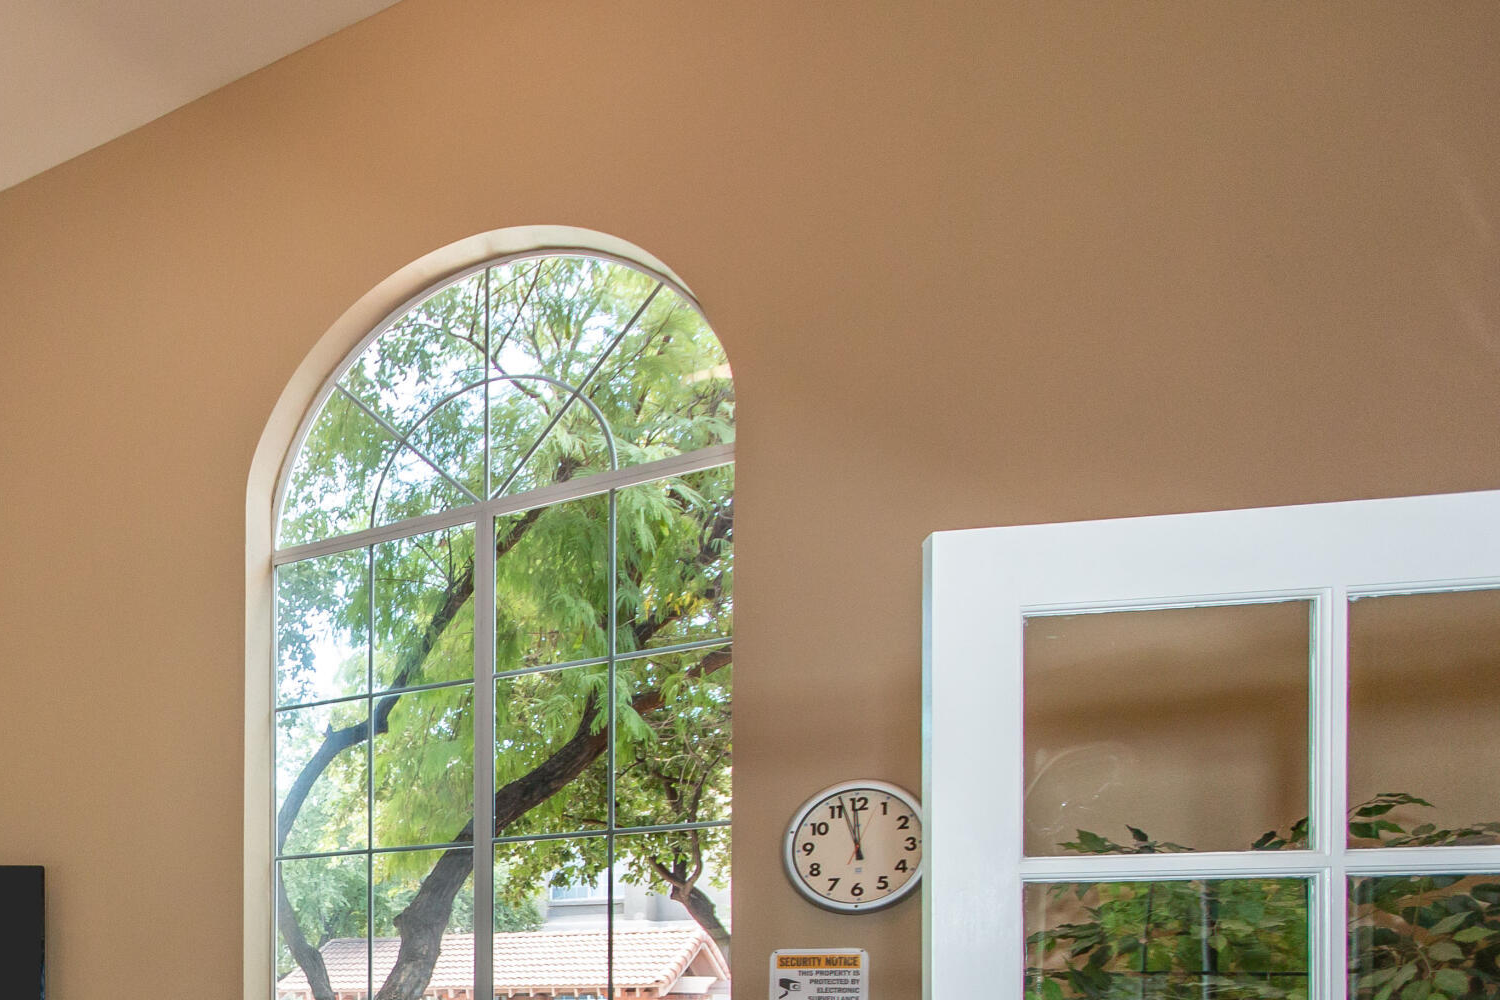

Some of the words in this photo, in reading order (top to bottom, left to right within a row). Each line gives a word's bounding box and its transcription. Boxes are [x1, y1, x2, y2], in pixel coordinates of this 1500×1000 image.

[850, 797, 868, 811] 12
[881, 802, 888, 815] 1
[829, 805, 844, 819] 11
[810, 822, 829, 836] 10
[896, 815, 909, 830] 2
[802, 842, 815, 856] 9
[904, 837, 917, 851] 3
[809, 862, 821, 877] 8
[894, 859, 908, 873] 4
[827, 878, 841, 891] 7
[850, 883, 864, 896] 6
[876, 876, 888, 890] 5
[779, 956, 822, 967] SECURITY
[825, 956, 859, 967] NOTICE
